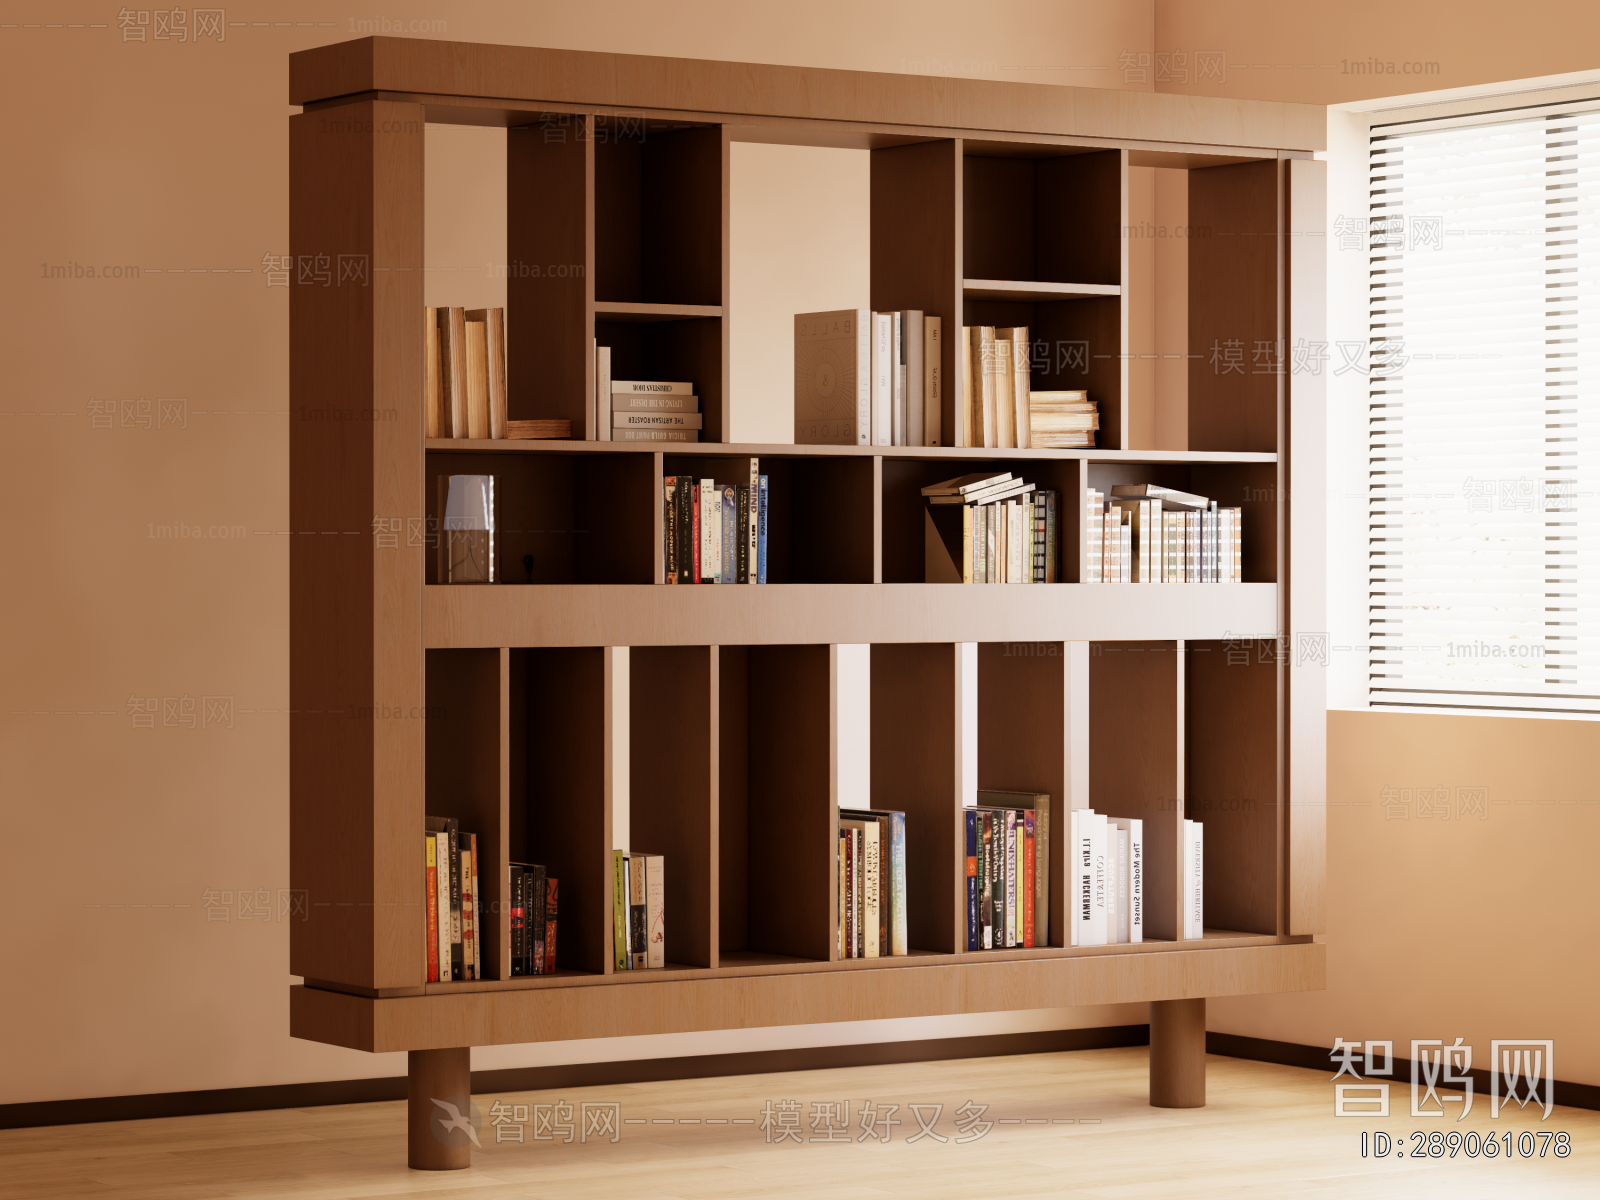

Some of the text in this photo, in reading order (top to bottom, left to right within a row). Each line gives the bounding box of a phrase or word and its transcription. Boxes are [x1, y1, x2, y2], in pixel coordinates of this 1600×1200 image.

[630, 399, 648, 407] DESERT
[648, 399, 658, 407] THE
[665, 400, 683, 408] LIVING
[628, 416, 651, 424] ROASTER
[651, 432, 667, 440] GUILD
[668, 432, 687, 440] TRICIA
